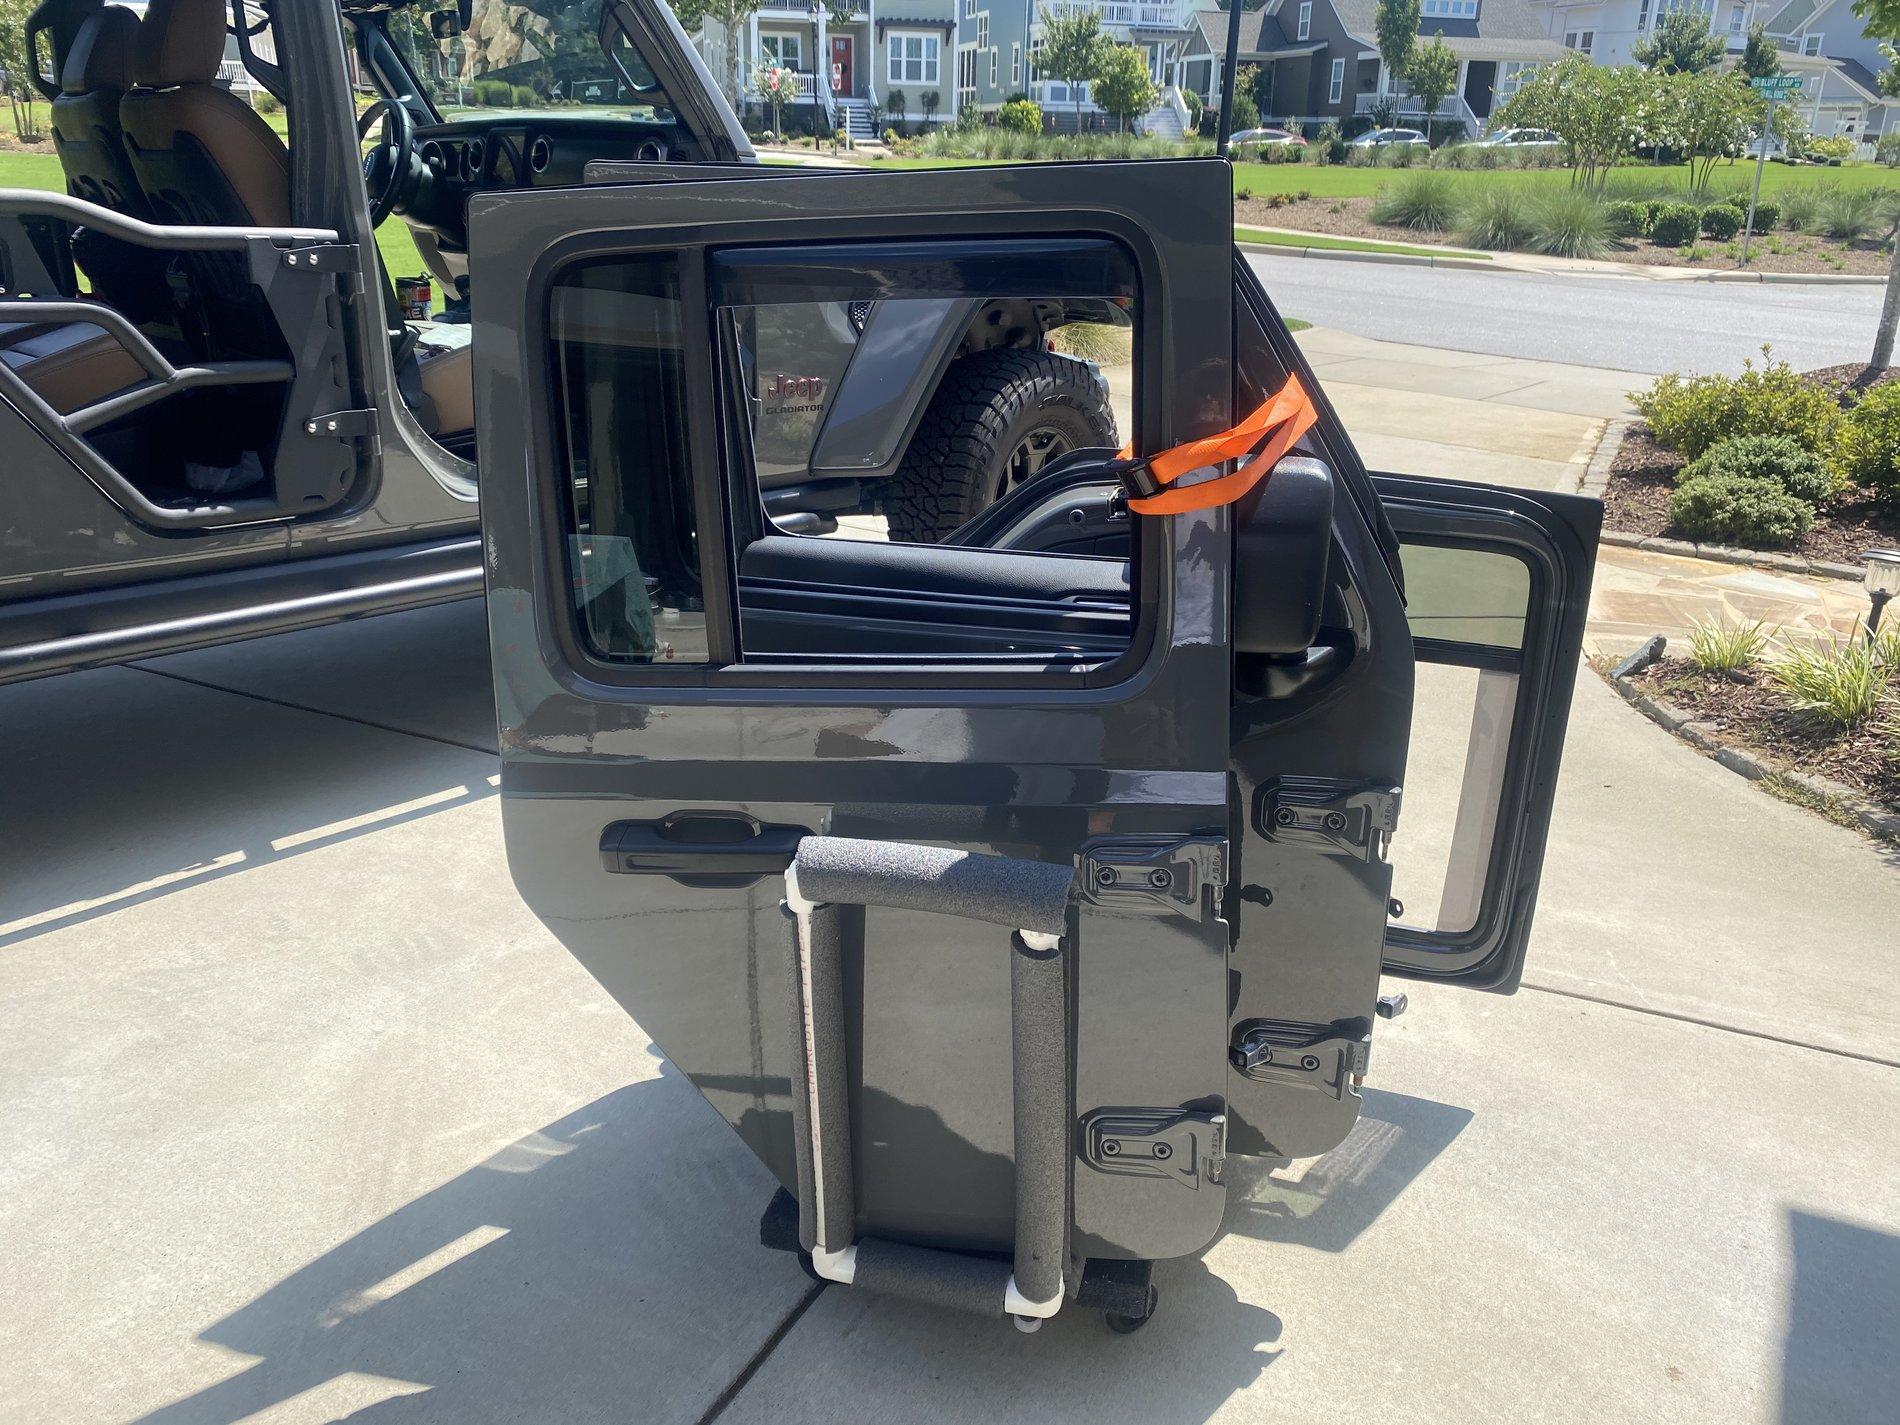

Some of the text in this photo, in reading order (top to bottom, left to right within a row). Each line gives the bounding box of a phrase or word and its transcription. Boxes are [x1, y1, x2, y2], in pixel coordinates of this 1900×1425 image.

[1761, 78, 1778, 87] BLUFF
[1779, 78, 1794, 87] LOOP
[768, 374, 824, 401] Jeep
[765, 404, 824, 415] GLADIATOR
